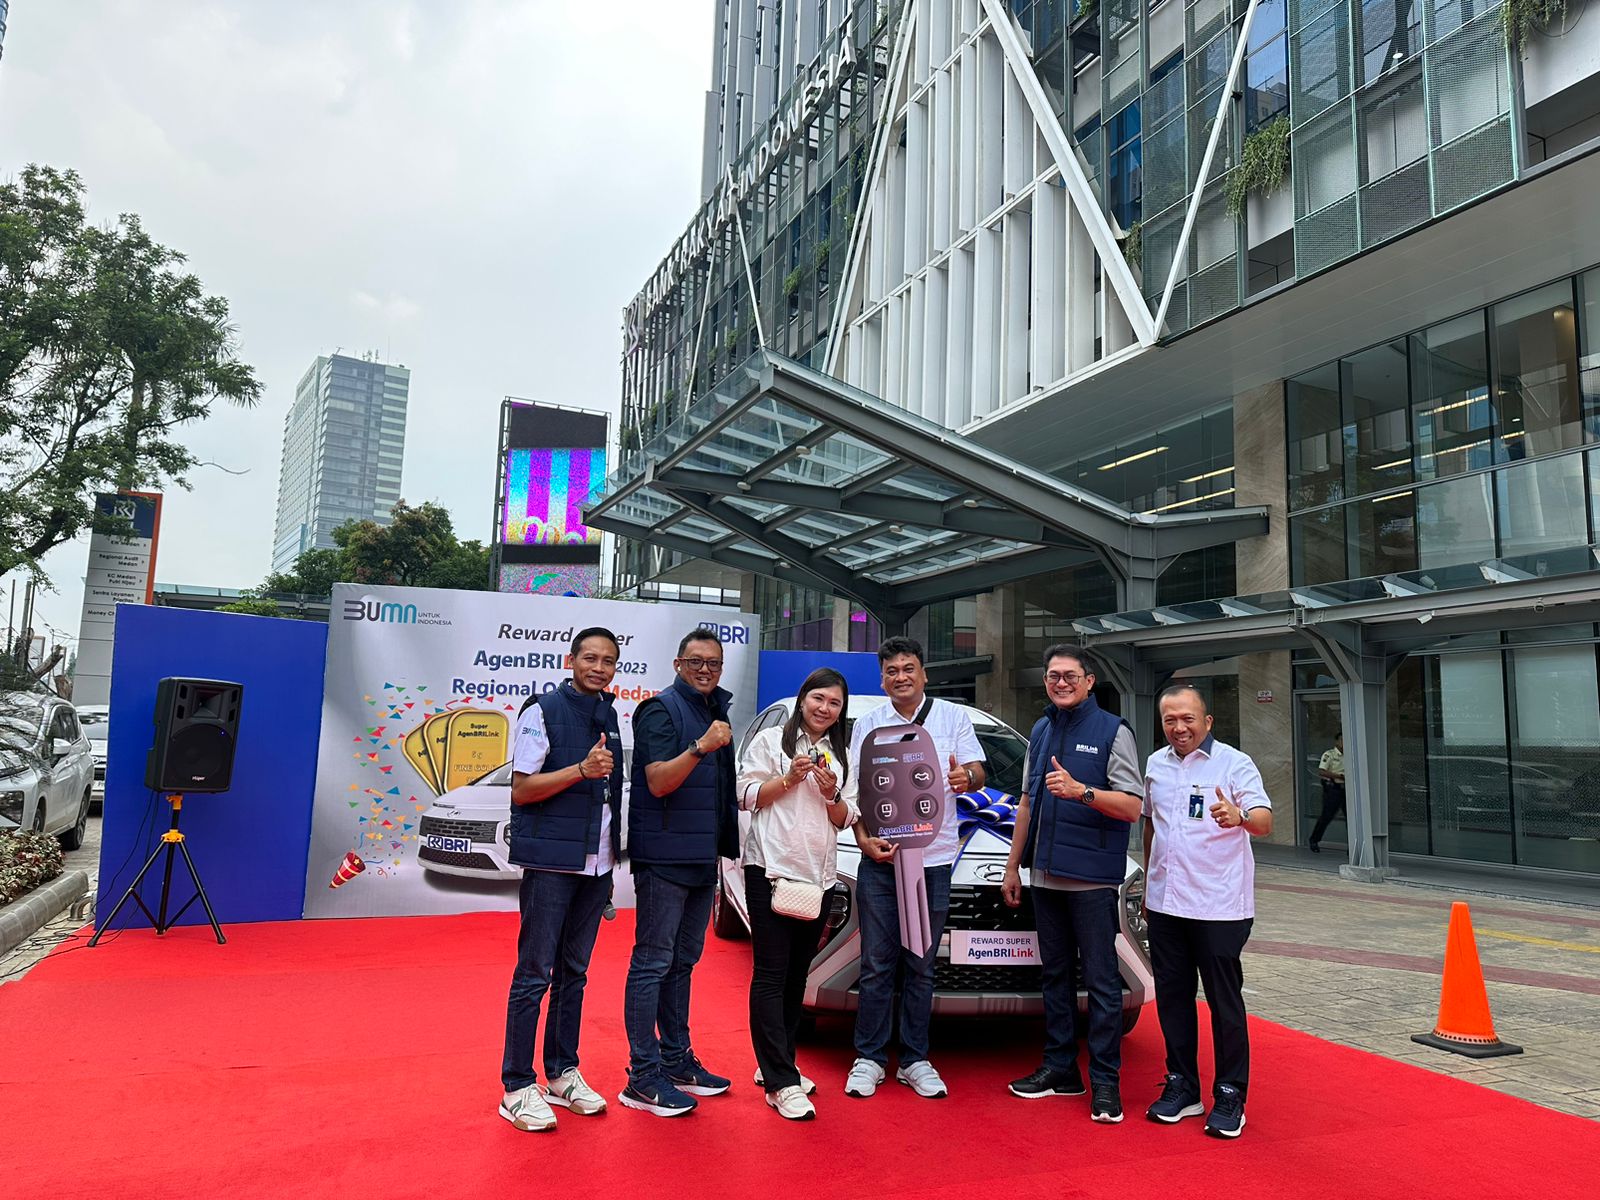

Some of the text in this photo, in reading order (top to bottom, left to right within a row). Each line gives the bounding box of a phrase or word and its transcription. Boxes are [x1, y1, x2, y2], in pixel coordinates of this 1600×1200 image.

[646, 260, 679, 319] BANK
[740, 35, 857, 200] INDONESIA
[498, 623, 574, 643] Reward
[473, 650, 648, 675] AgenBRIL 2023
[452, 678, 536, 699] Regional
[457, 730, 500, 738] AgenBRILink
[971, 937, 1031, 945] REWARD SUPER
[968, 948, 1034, 960] AgenBRILink
